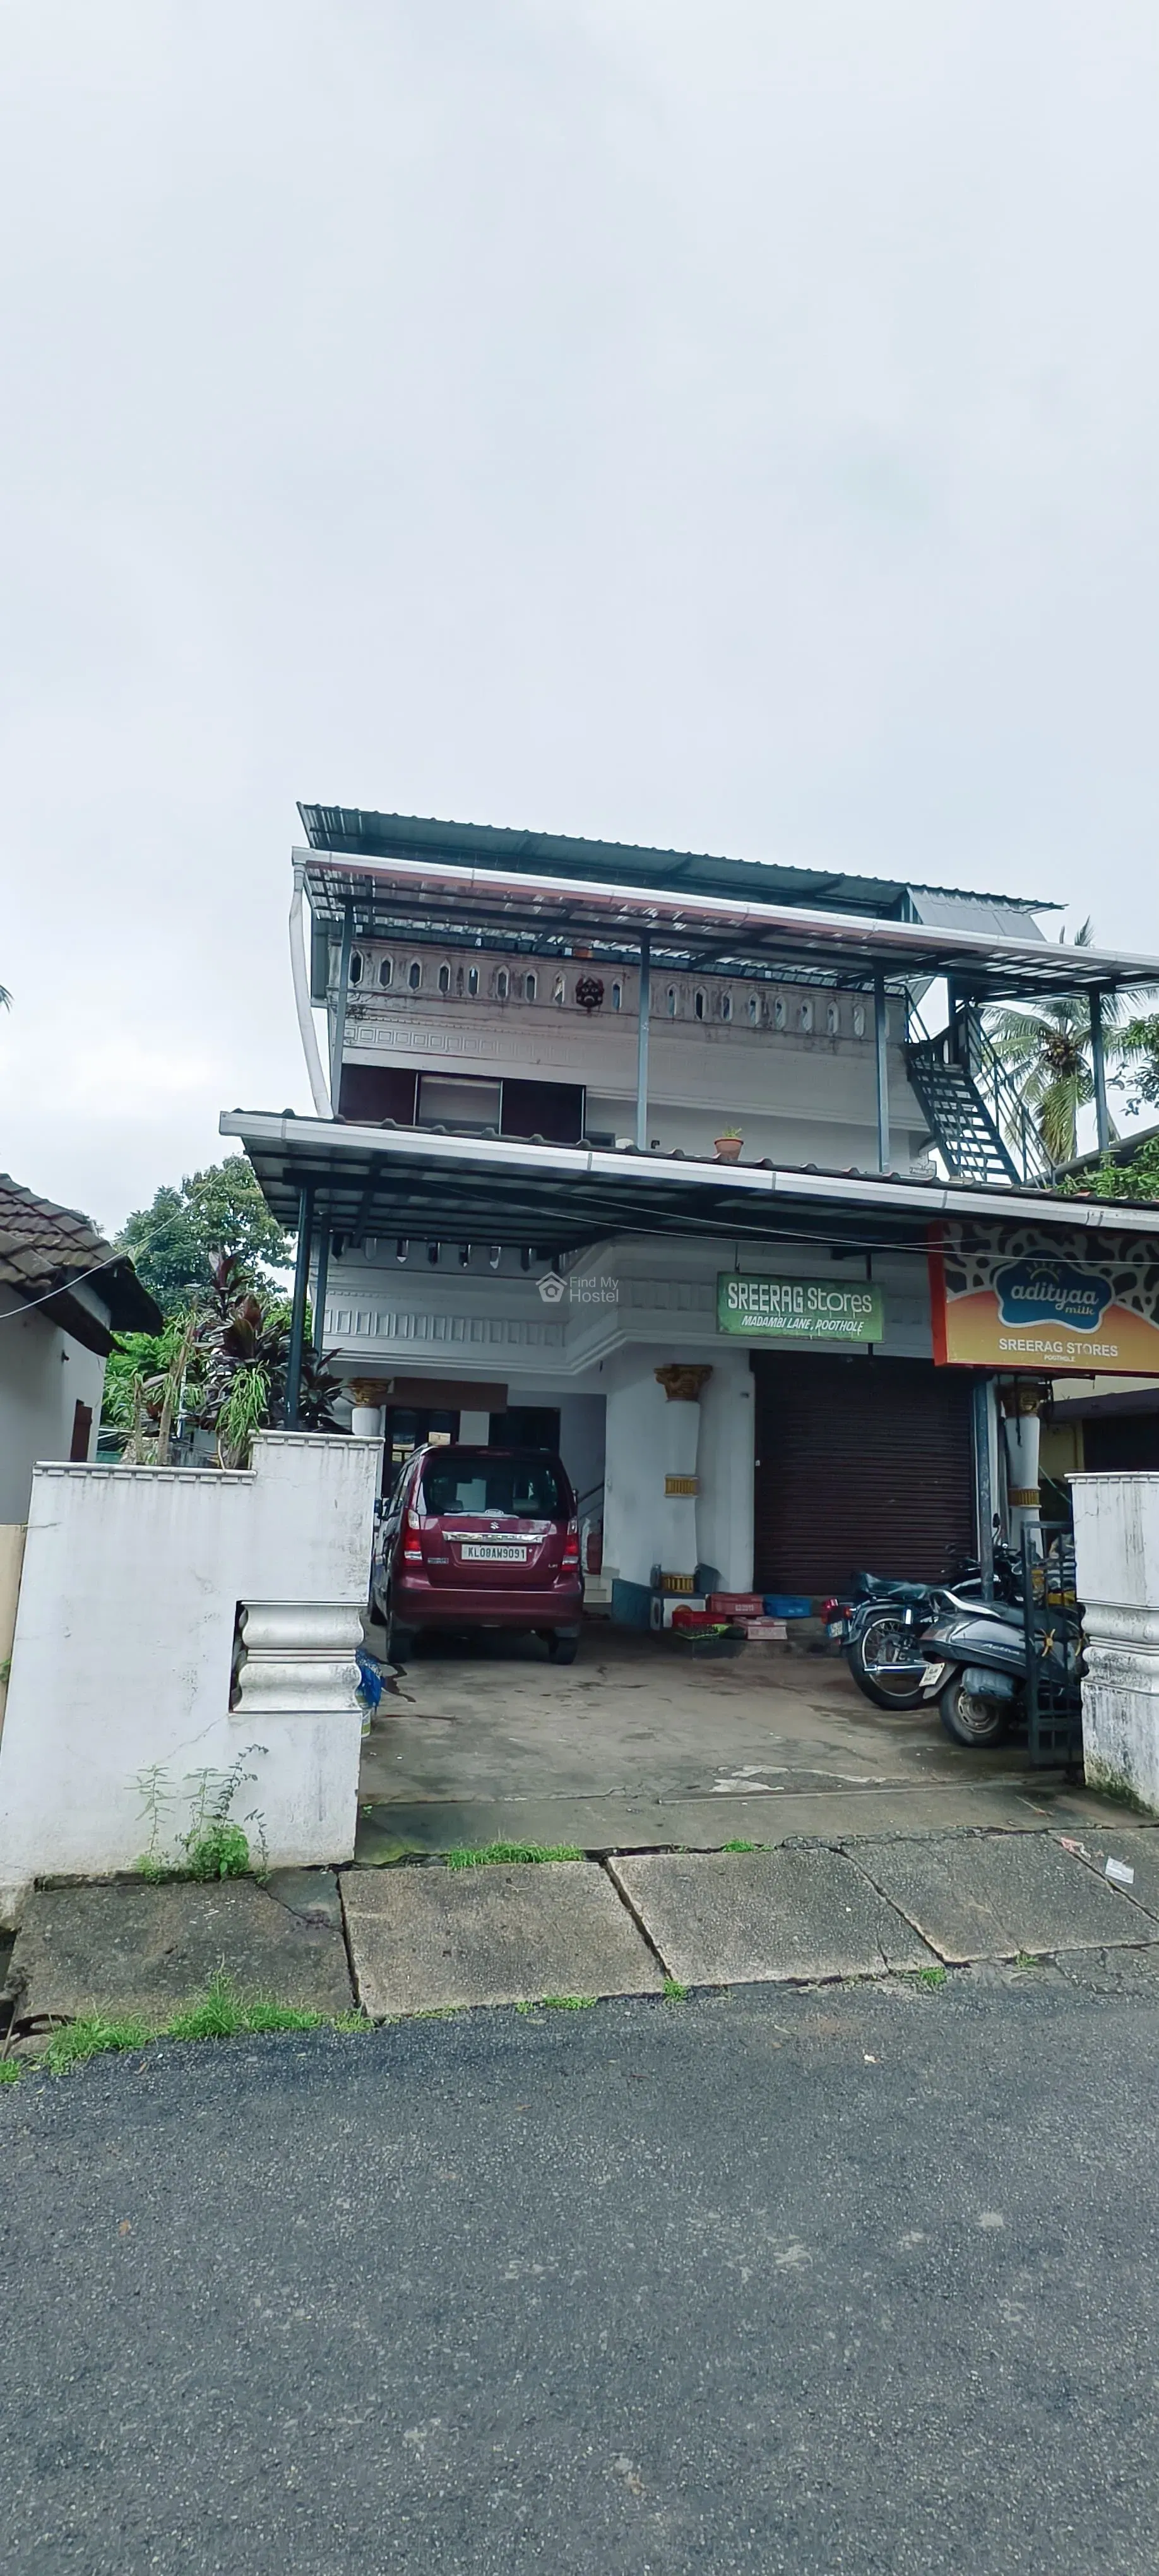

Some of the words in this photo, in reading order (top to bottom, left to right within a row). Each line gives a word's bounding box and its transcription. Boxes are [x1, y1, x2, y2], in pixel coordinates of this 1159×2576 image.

[728, 1282, 804, 1313] SREERAG
[808, 1287, 872, 1313] Stores
[1011, 1282, 1099, 1311] adityaa
[1065, 1305, 1095, 1315] milk
[741, 1315, 786, 1328] MADAMBI
[815, 1319, 864, 1332] POOTHOLE
[999, 1337, 1063, 1353] SREERAG
[1066, 1342, 1119, 1357] STORES
